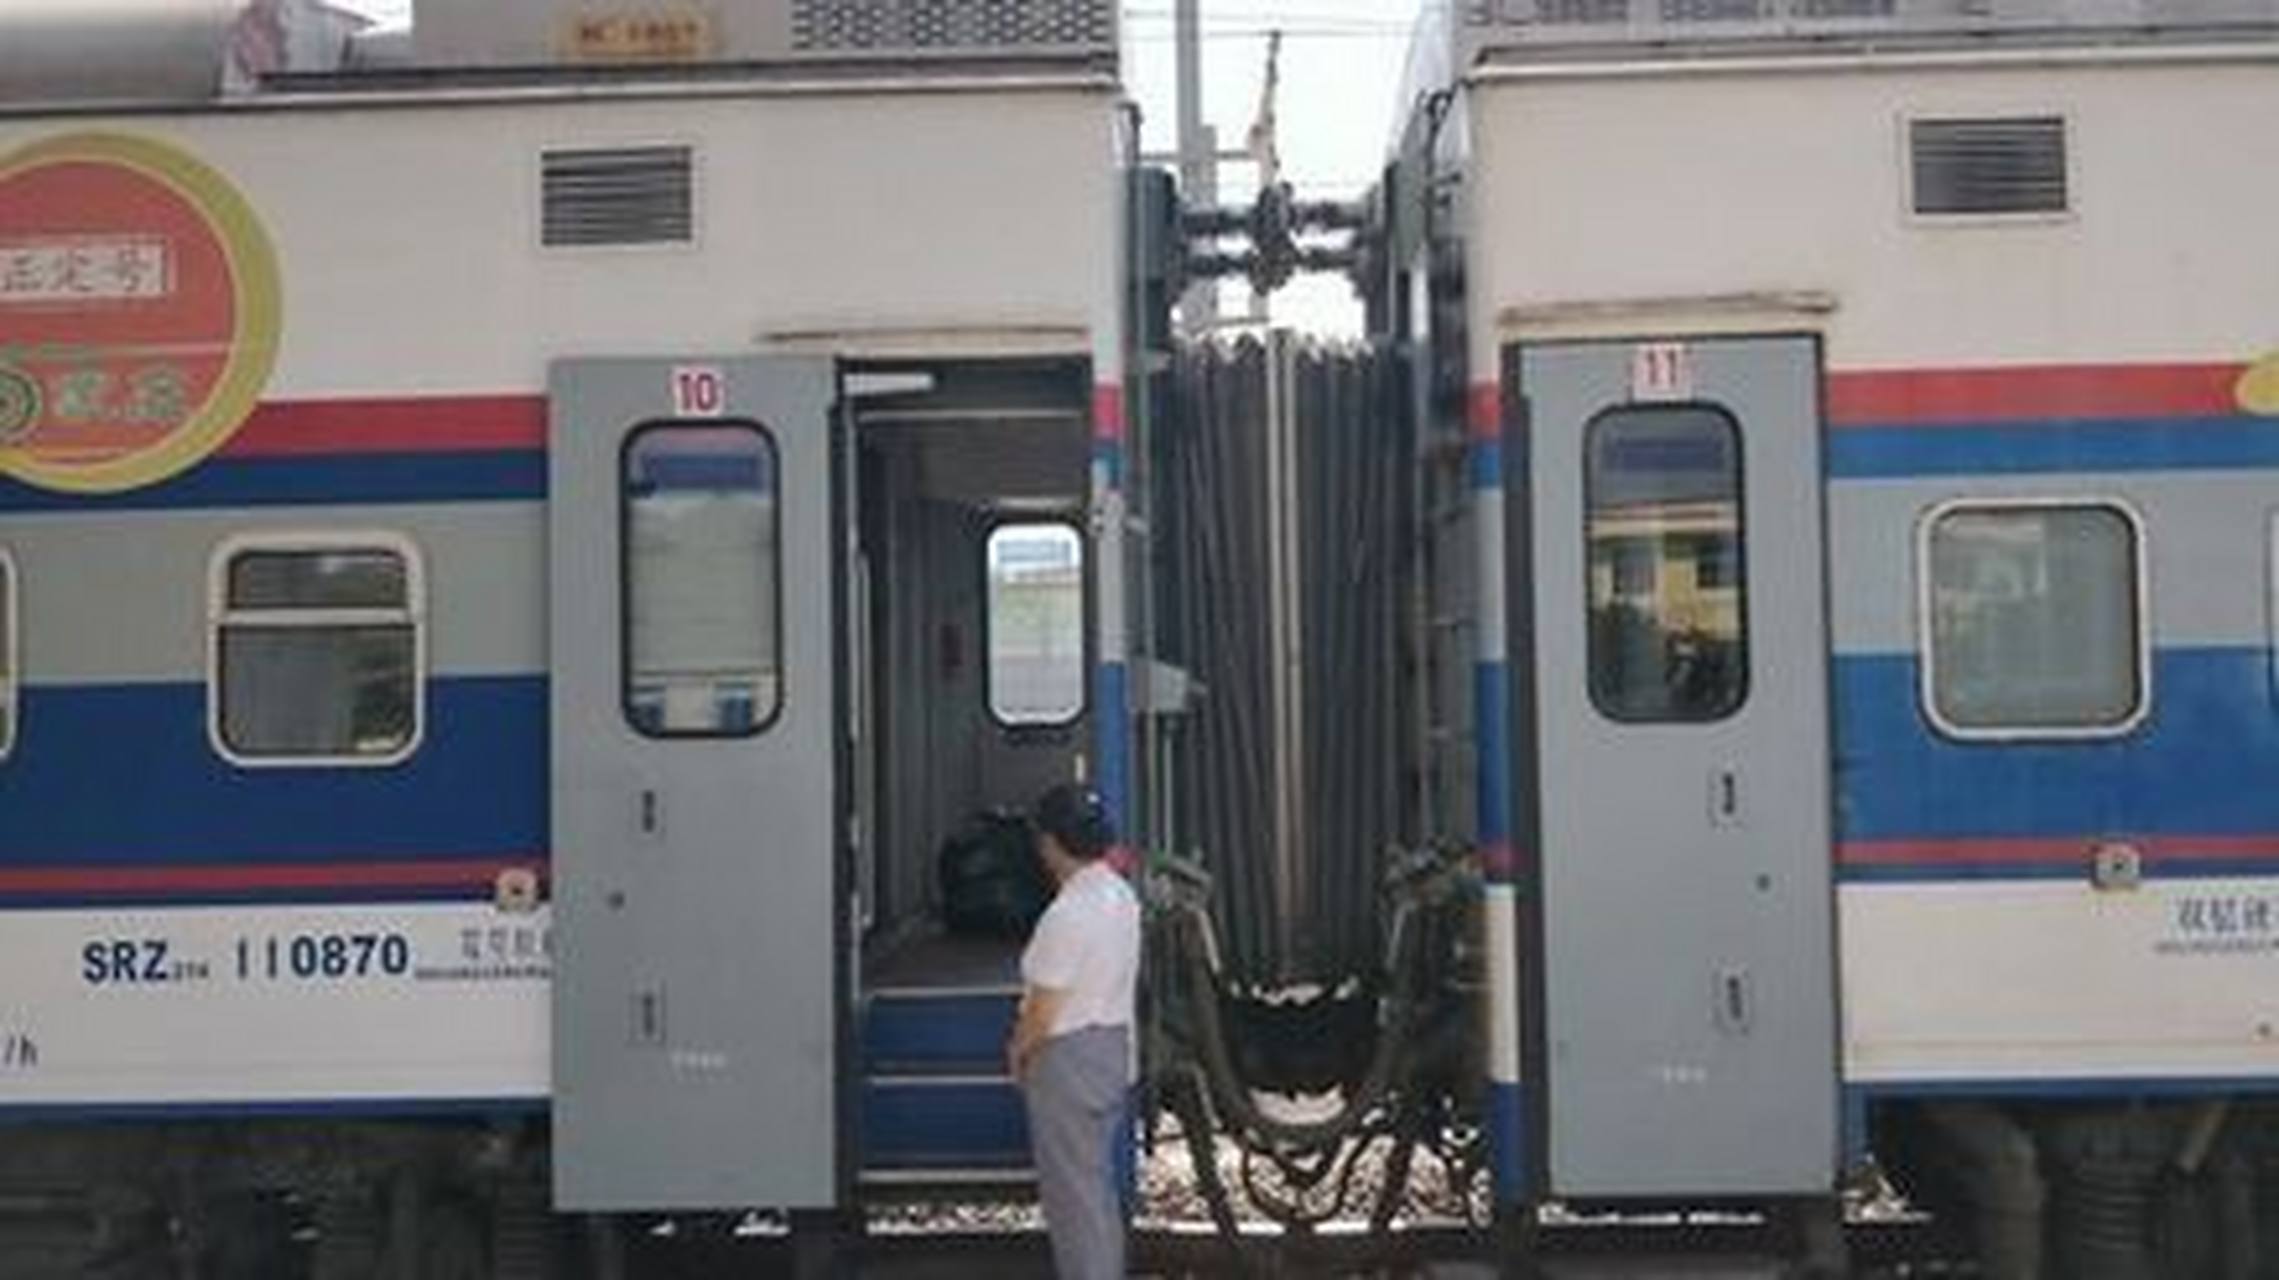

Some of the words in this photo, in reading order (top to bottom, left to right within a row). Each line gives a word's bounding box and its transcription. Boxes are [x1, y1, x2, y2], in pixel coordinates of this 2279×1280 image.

[1645, 350, 1678, 388] 11
[678, 372, 717, 411] 10
[82, 939, 168, 984] SRZ
[236, 934, 409, 980] 110870
